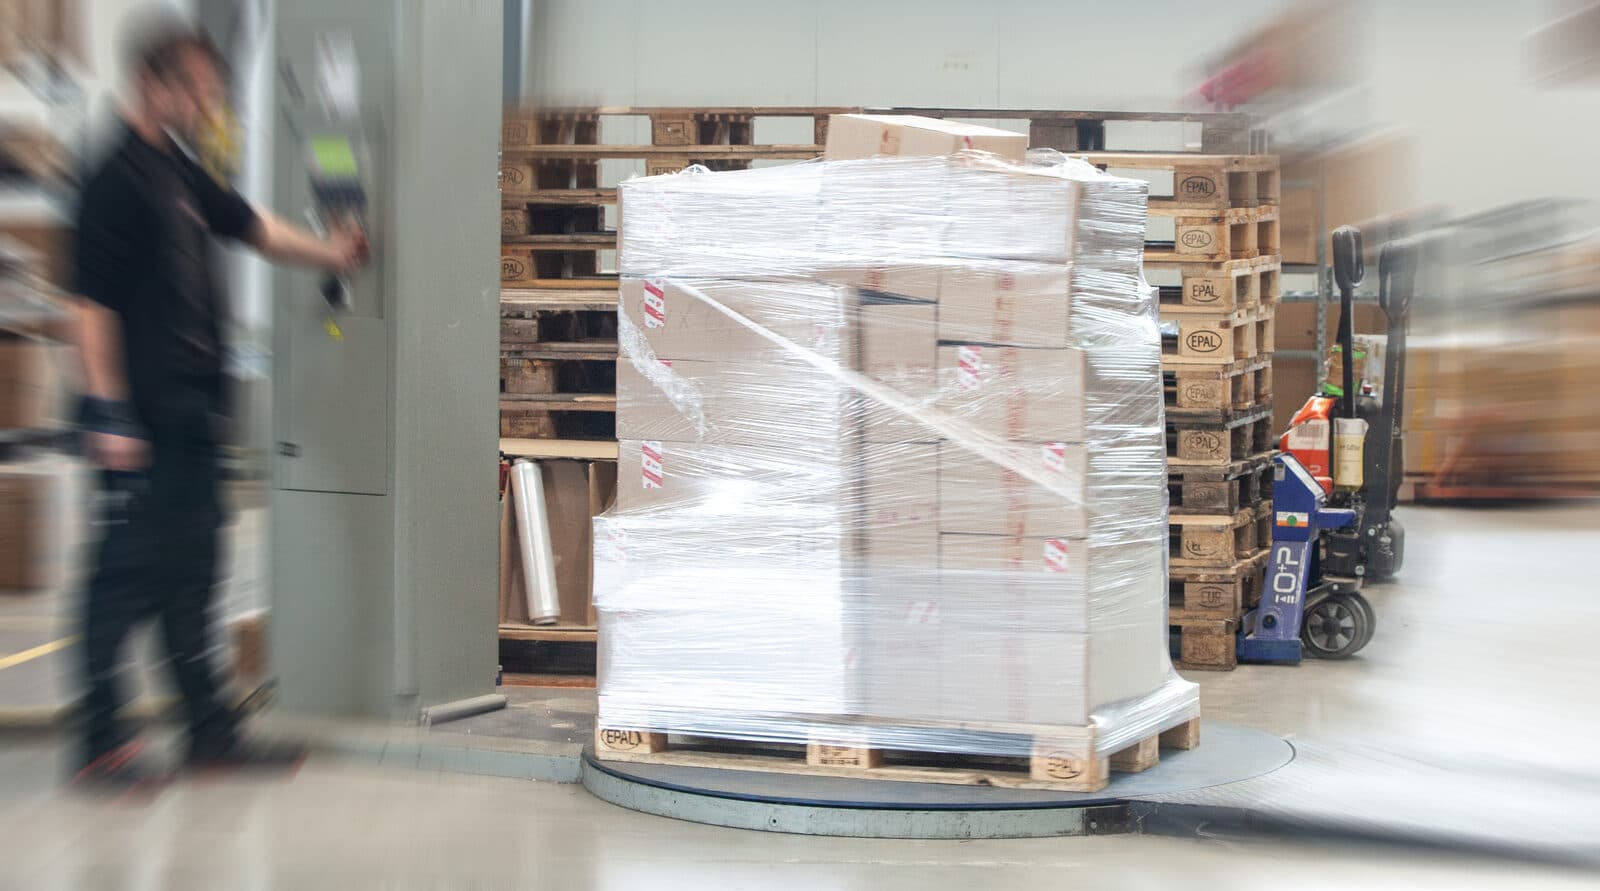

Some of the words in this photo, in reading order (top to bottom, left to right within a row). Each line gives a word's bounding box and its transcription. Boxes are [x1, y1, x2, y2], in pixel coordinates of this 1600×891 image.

[1186, 181, 1212, 194] EPAL
[1186, 234, 1209, 245] EPAL
[503, 263, 520, 275] PAL
[1192, 284, 1218, 297] EPAL
[1191, 335, 1217, 348] EPAL
[1189, 436, 1215, 449] EPAL
[606, 729, 636, 746] EPAL
